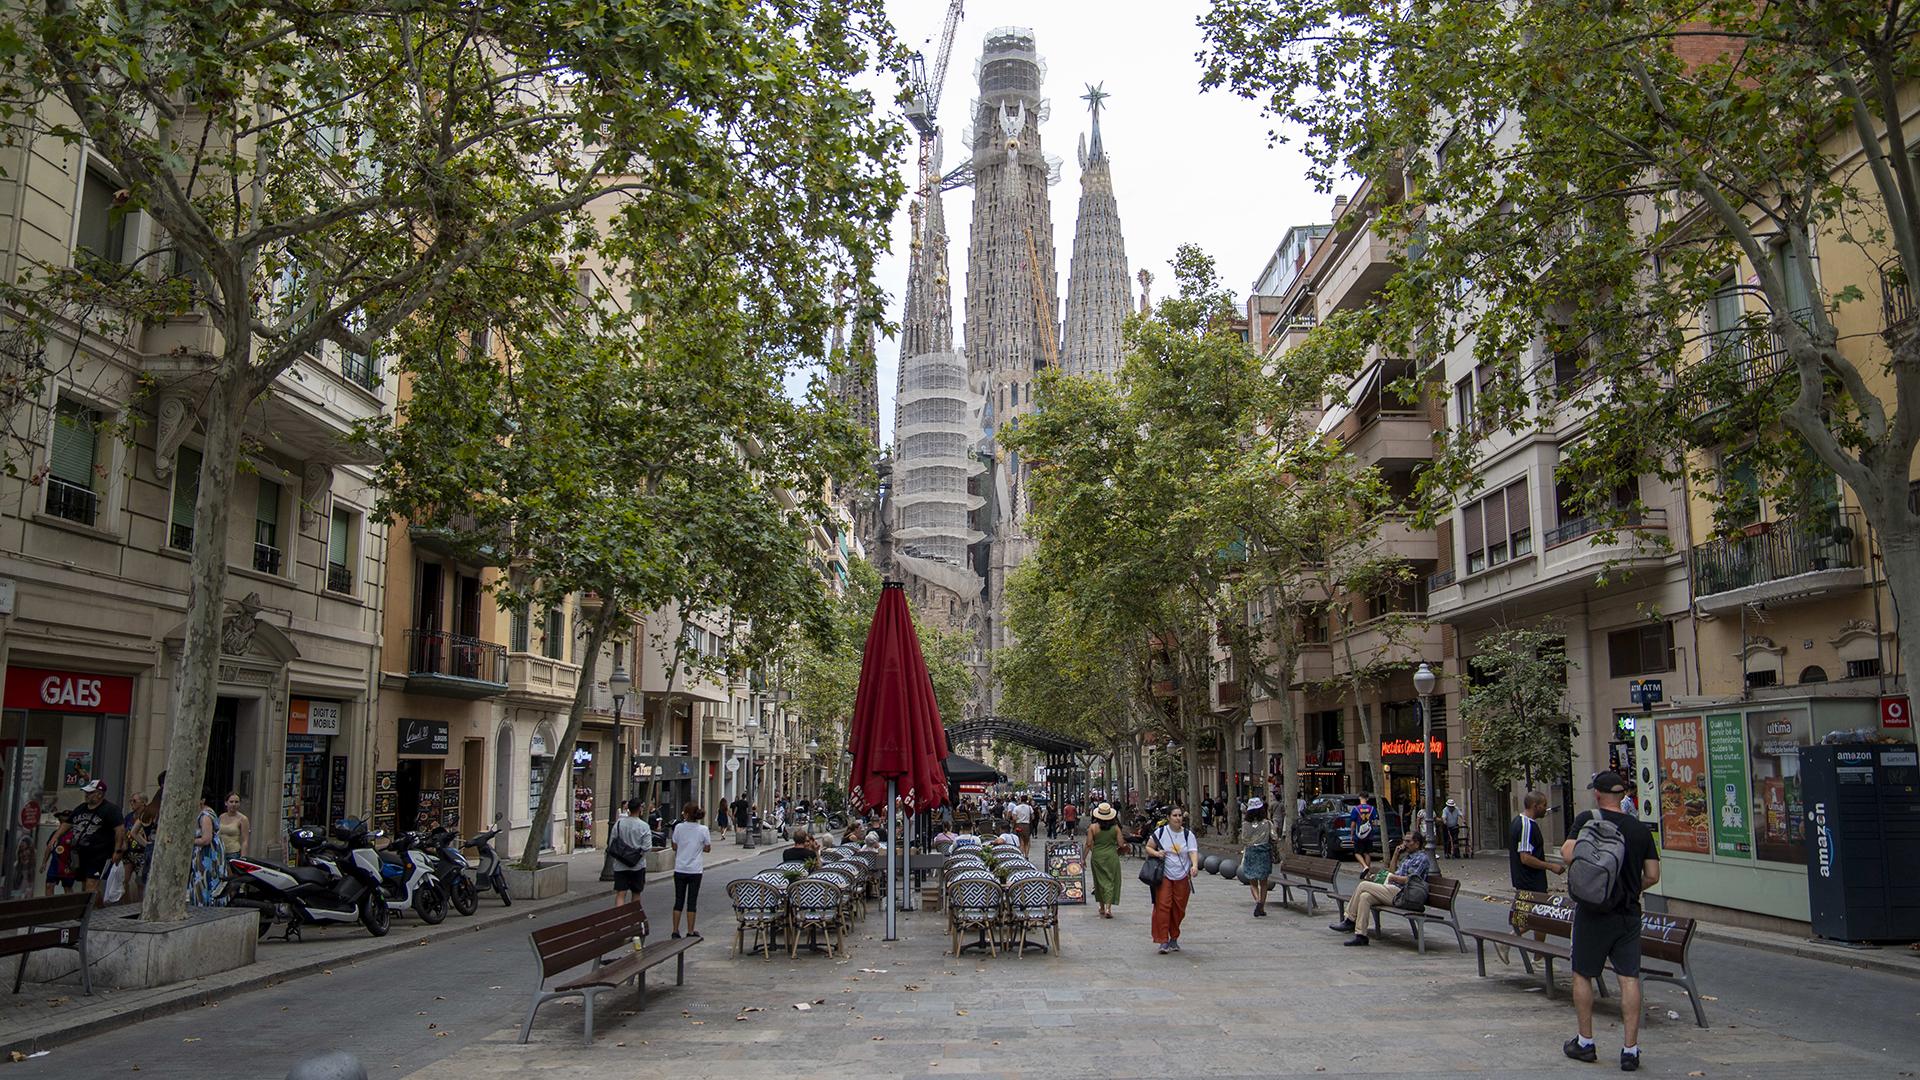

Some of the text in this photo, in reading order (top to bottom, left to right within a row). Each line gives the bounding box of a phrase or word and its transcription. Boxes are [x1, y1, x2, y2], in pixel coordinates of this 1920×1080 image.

[41, 675, 102, 707] GAES
[1642, 683, 1661, 691] ATM
[313, 708, 329, 717] DIGIT
[330, 709, 337, 718] 22
[313, 719, 336, 729] MOBILS
[1767, 721, 1791, 734] ultima
[1663, 722, 1697, 746] DOBLES
[1837, 751, 1872, 760] amazon
[1815, 802, 1830, 878] amazon
